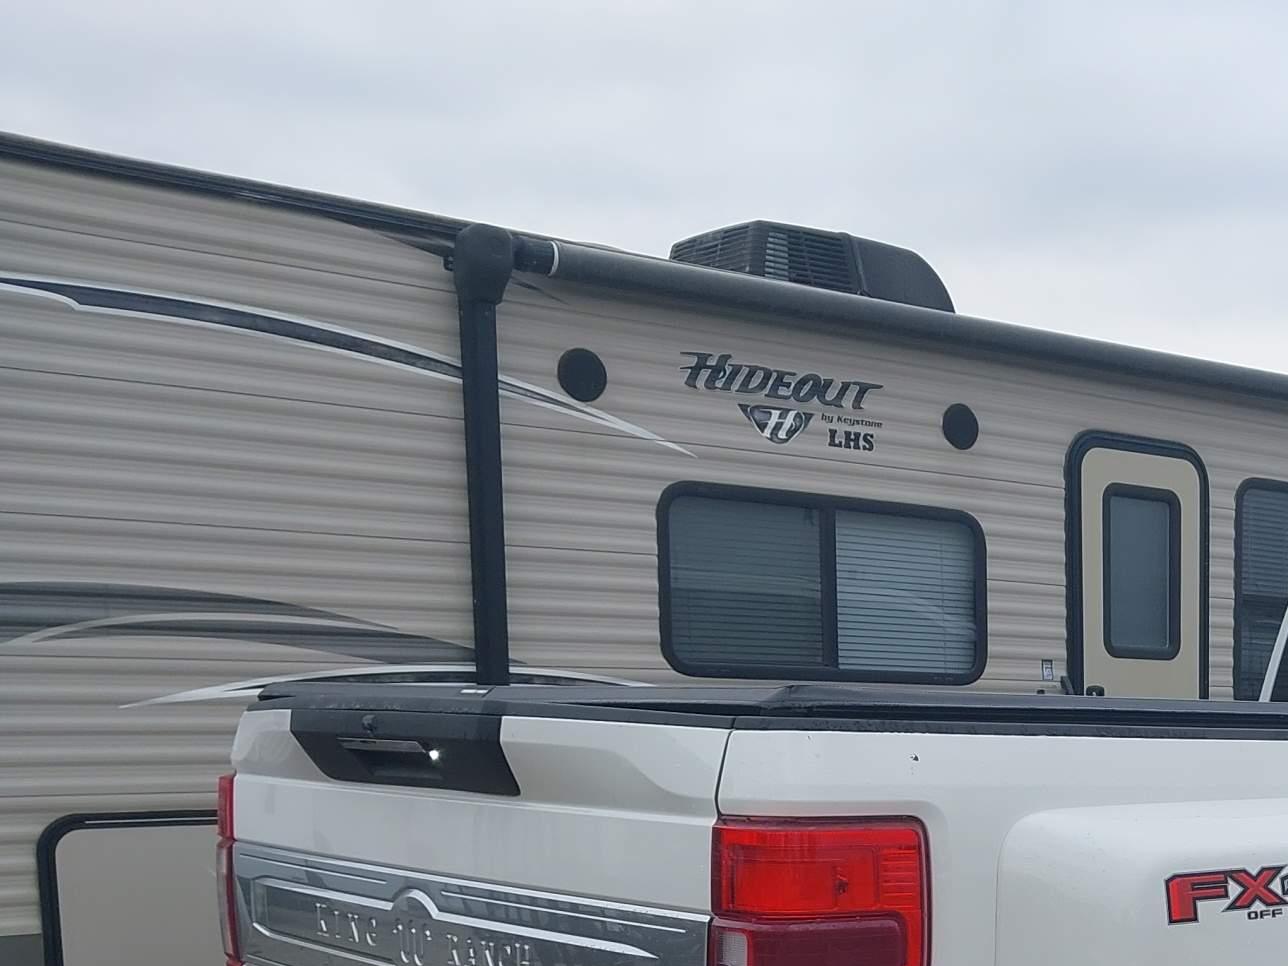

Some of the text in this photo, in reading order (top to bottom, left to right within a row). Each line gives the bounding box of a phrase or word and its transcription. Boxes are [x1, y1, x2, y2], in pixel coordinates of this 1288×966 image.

[680, 351, 884, 410] HIDEOUT
[821, 413, 834, 424] by
[828, 428, 875, 452] LHS
[315, 902, 377, 946] KING
[1247, 908, 1284, 921] OFF
